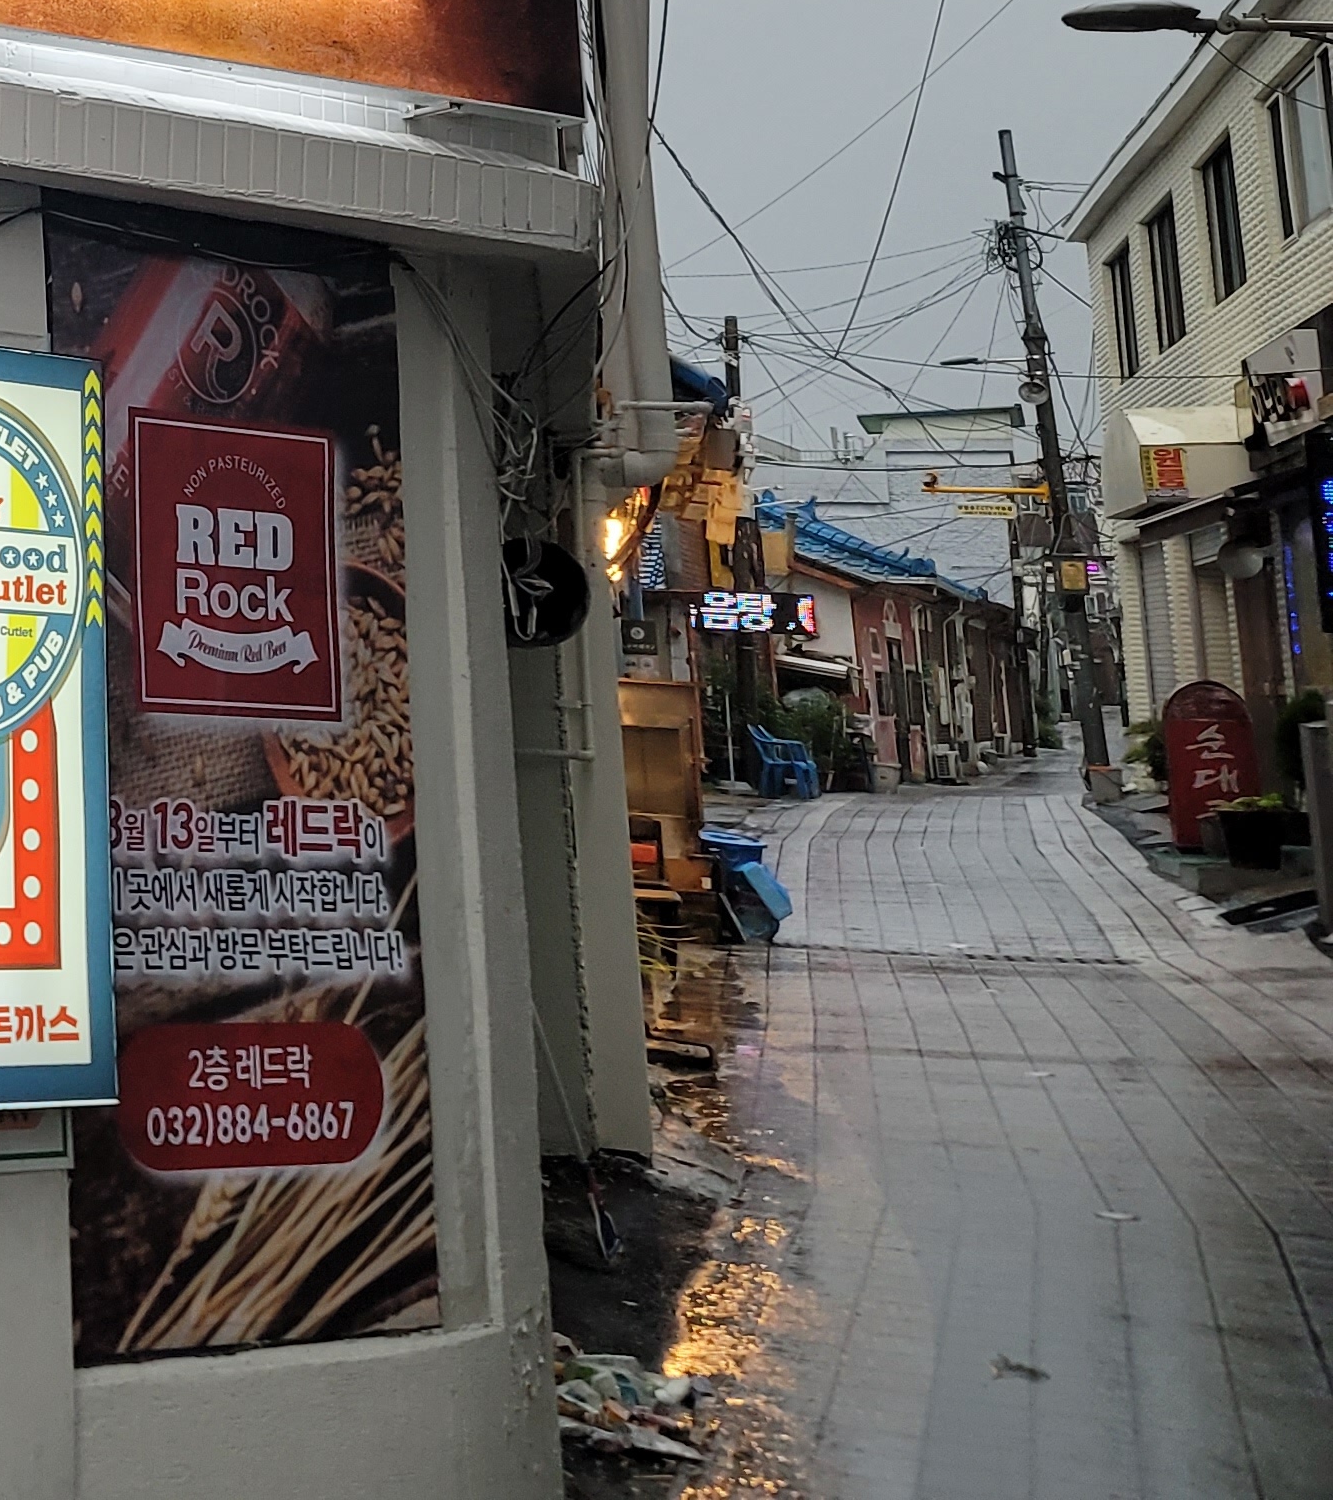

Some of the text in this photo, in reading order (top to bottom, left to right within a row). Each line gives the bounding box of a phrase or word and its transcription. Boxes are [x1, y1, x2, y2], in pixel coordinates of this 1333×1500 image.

[183, 455, 286, 509] NON PASTEURIZED
[175, 503, 294, 571] RED
[176, 568, 294, 622] Rock
[0, 624, 33, 638] Cutlet
[188, 629, 239, 663] Premium
[5, 683, 25, 706] &
[25, 629, 65, 688] PUB
[153, 800, 260, 855] 13일부터
[265, 800, 385, 858] 레드락이
[128, 870, 197, 912] 곳에서
[203, 870, 269, 913] 새롭게
[275, 871, 388, 914] 시작합니다.
[141, 929, 211, 971] 관심과
[217, 930, 262, 971] 방문
[267, 930, 403, 971] 부탁드립니다!
[189, 1043, 312, 1091] 2층 레드락
[146, 1102, 356, 1146] 032)884-6867
